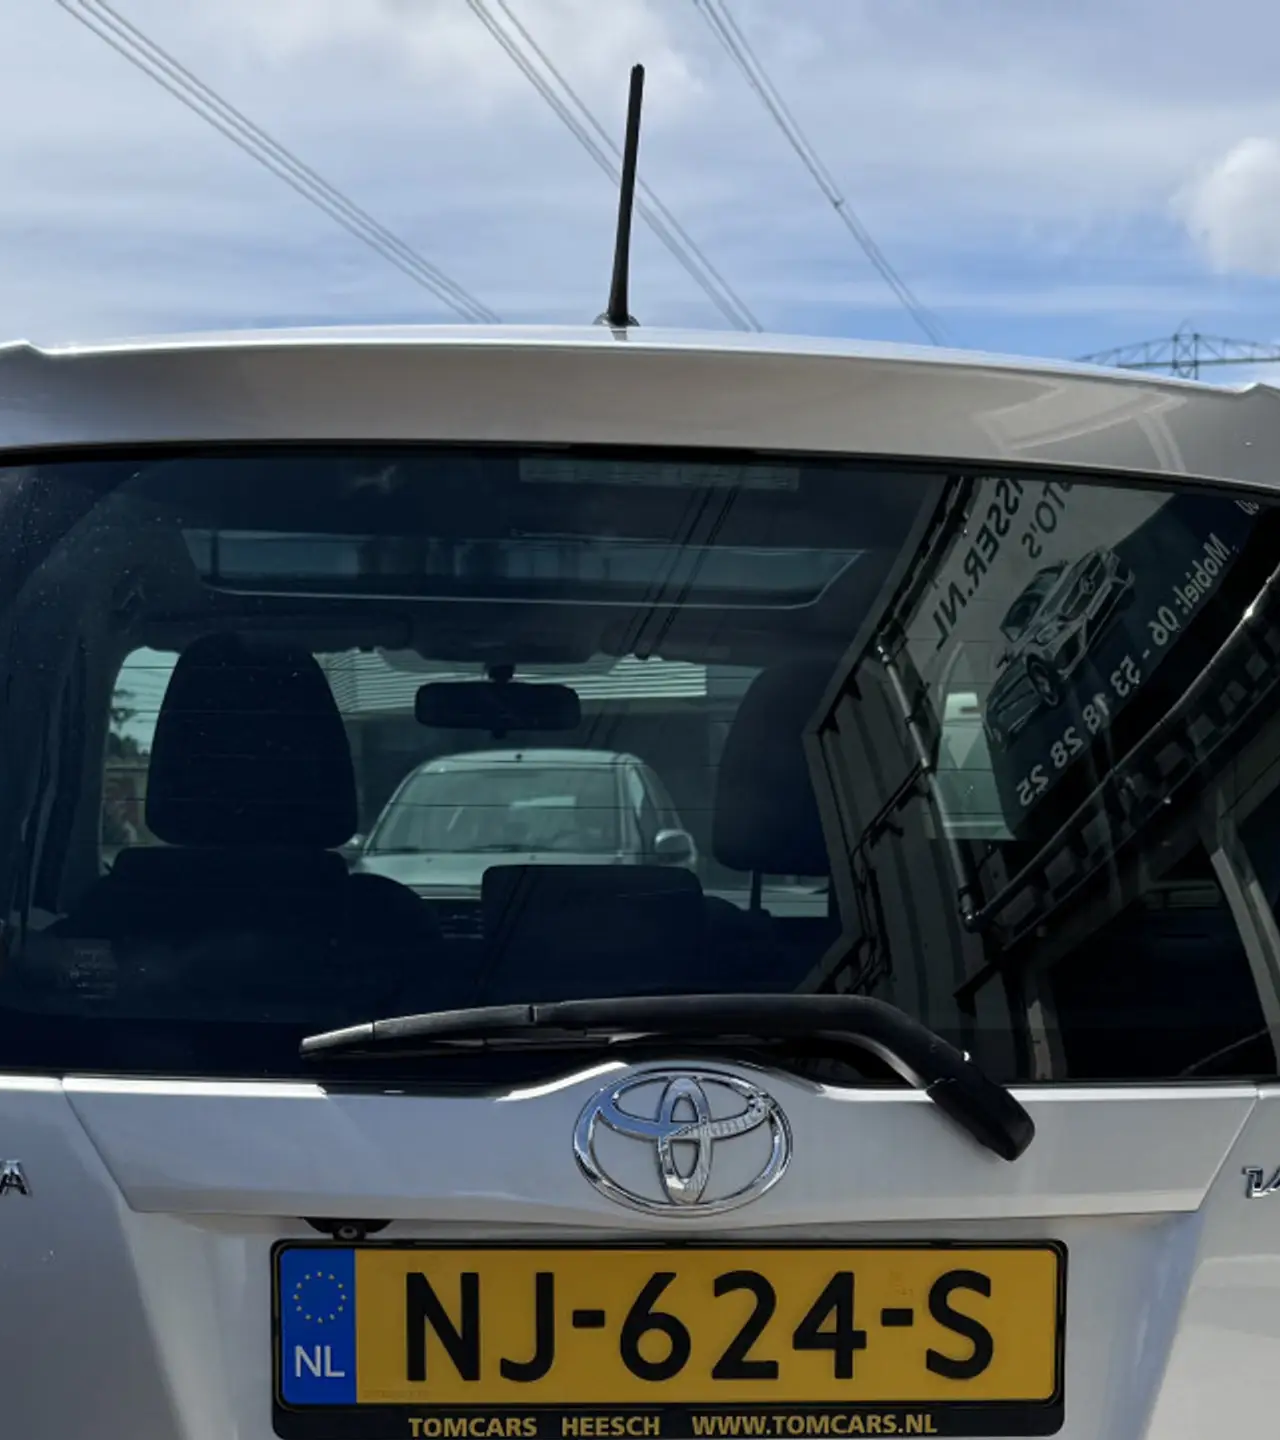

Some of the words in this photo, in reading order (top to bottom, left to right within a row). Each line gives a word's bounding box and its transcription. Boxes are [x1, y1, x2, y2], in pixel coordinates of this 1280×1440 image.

[406, 1269, 994, 1383] NJ-624-S
[294, 1344, 345, 1378] NL
[408, 1416, 537, 1438] TOMCARS
[561, 1415, 661, 1437] HEESCH
[691, 1414, 938, 1436] WWW.TOMCARS.NL
